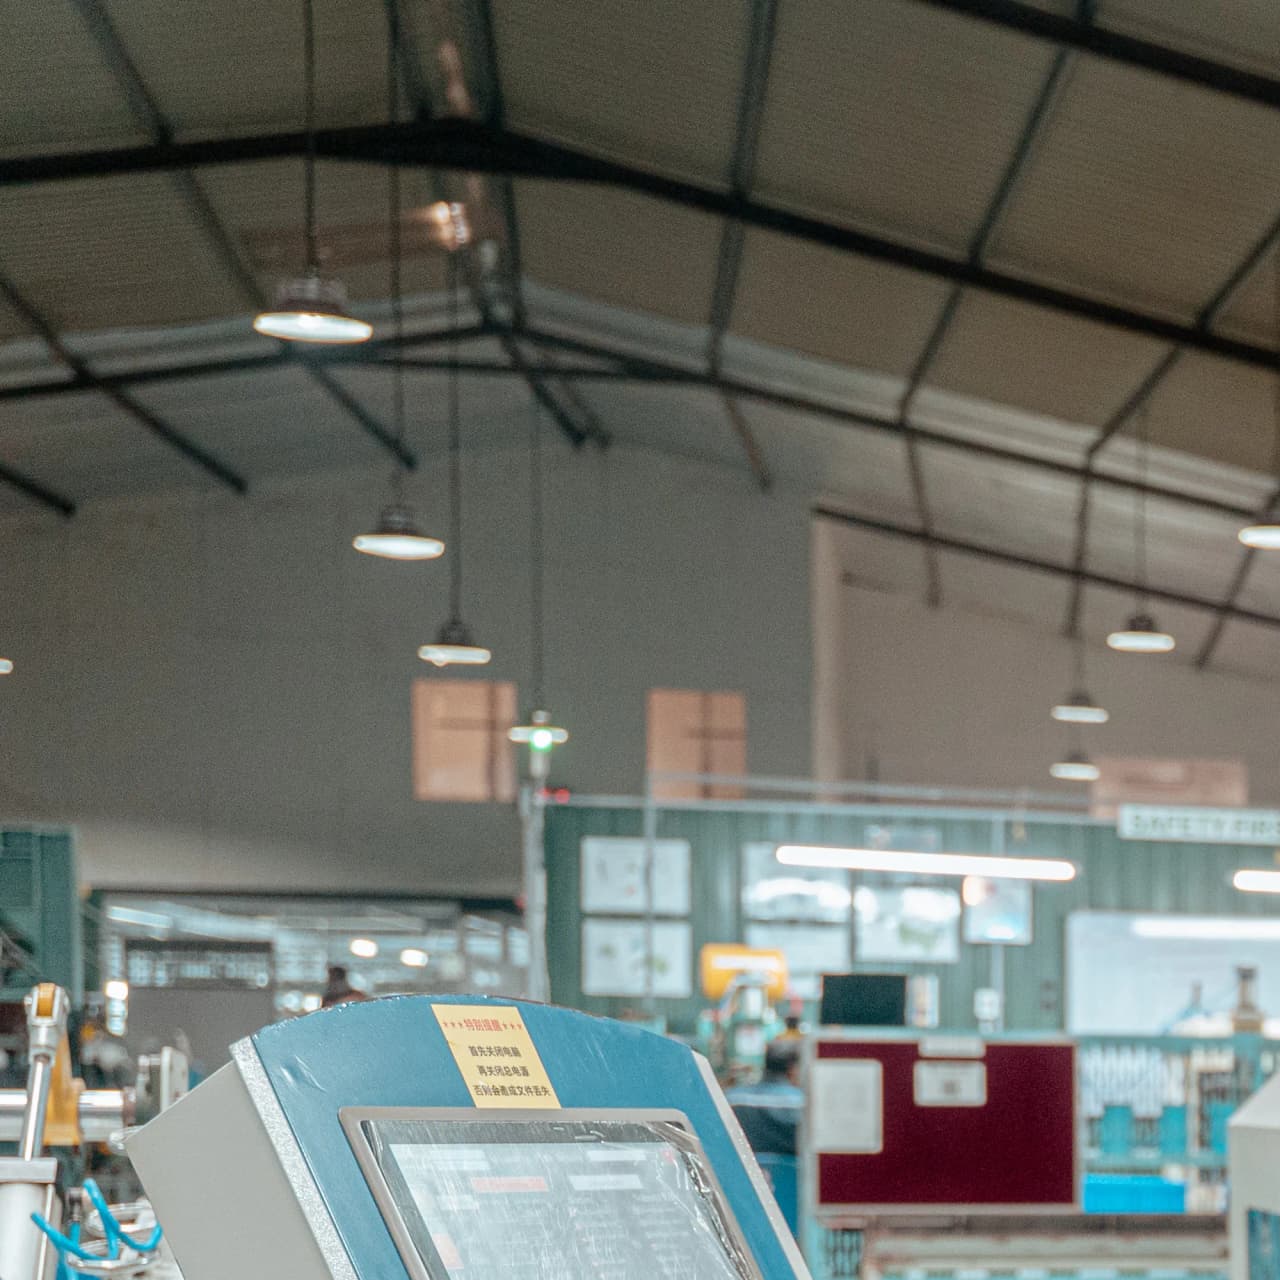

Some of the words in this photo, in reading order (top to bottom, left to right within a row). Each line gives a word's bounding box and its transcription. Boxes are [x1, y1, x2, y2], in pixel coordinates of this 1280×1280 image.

[468, 1045, 522, 1057] 首先关闭电脑
[476, 1065, 530, 1077] 再关闭总电源
[472, 1084, 551, 1096] 否则会造成文件丢失
